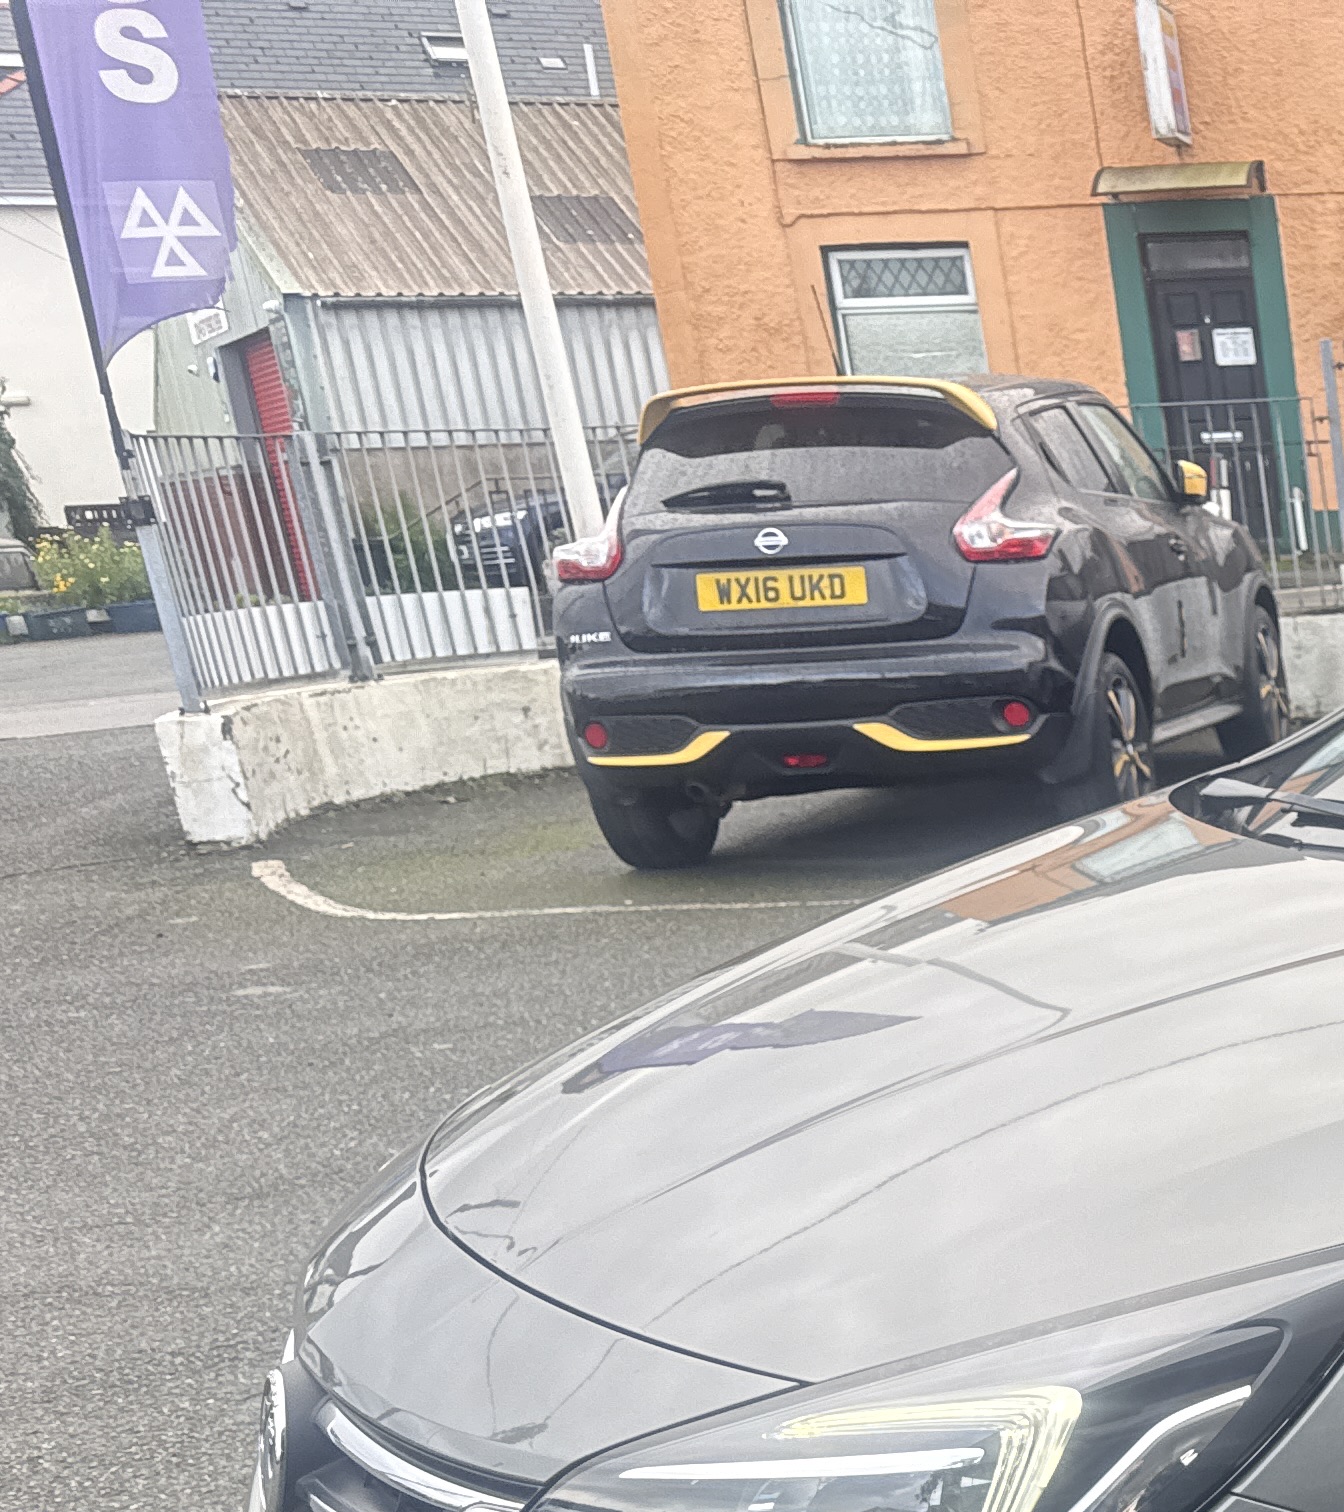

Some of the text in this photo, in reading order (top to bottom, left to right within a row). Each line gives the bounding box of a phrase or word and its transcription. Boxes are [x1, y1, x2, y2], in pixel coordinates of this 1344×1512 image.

[93, 0, 179, 104] S
[715, 573, 847, 605] WX16 UKD
